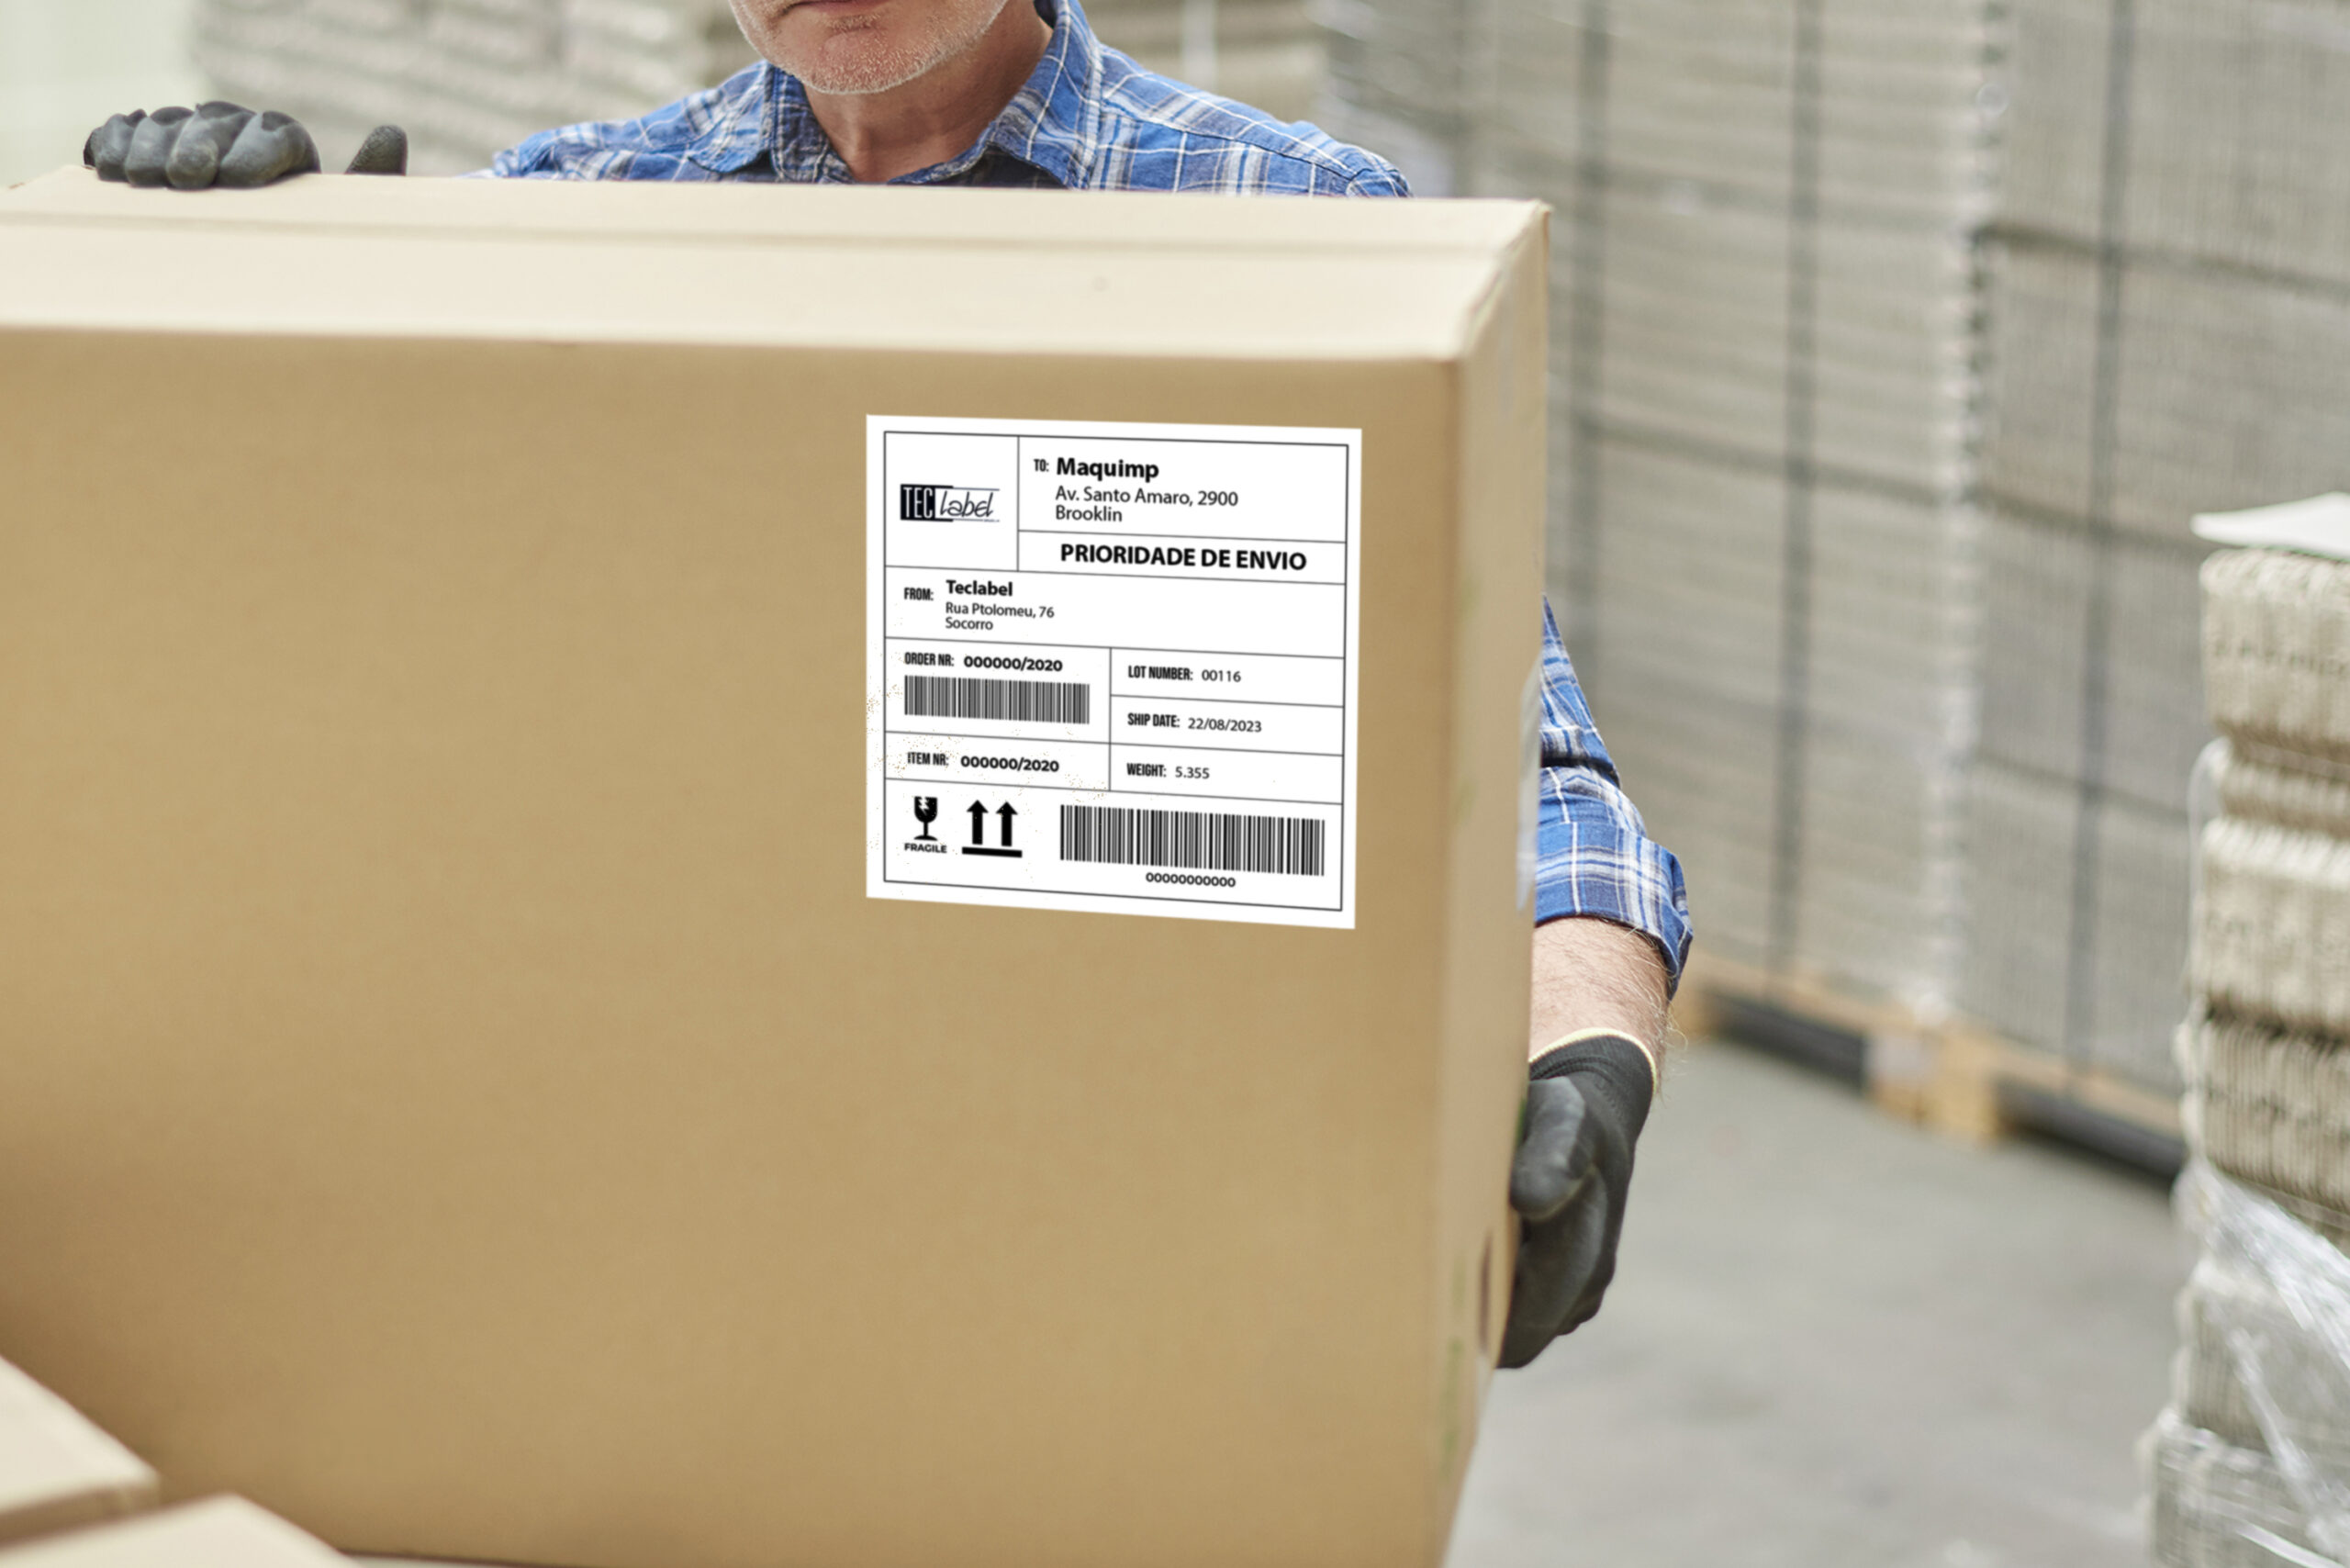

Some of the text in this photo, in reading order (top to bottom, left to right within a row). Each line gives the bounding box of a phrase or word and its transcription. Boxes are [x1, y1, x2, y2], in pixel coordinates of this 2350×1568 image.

[1034, 456, 1159, 484] TO: Maquimp
[1055, 485, 1238, 507] Av. Santo Amaro, 2900
[1056, 504, 1123, 522] Brooklin
[1060, 543, 1307, 571] PRIORIDADE DE ENVIO
[903, 587, 934, 601] FROM:
[946, 579, 1013, 597] Teclabel
[946, 601, 1055, 618] Rua Ptolomeu, 76
[946, 616, 993, 631] Socorro
[904, 652, 1063, 672] ORDER NR: 000000/2020
[1128, 665, 1241, 683] LOT NUMBER: 00116
[1127, 712, 1262, 733] SHIP DATE: 22/08/2023
[907, 751, 1060, 773] ITEM NR: 000000/2020
[1126, 763, 1210, 779] WEIGHT: 5.355
[904, 842, 947, 854] FRAGILE
[1145, 872, 1237, 888] 00000000000
